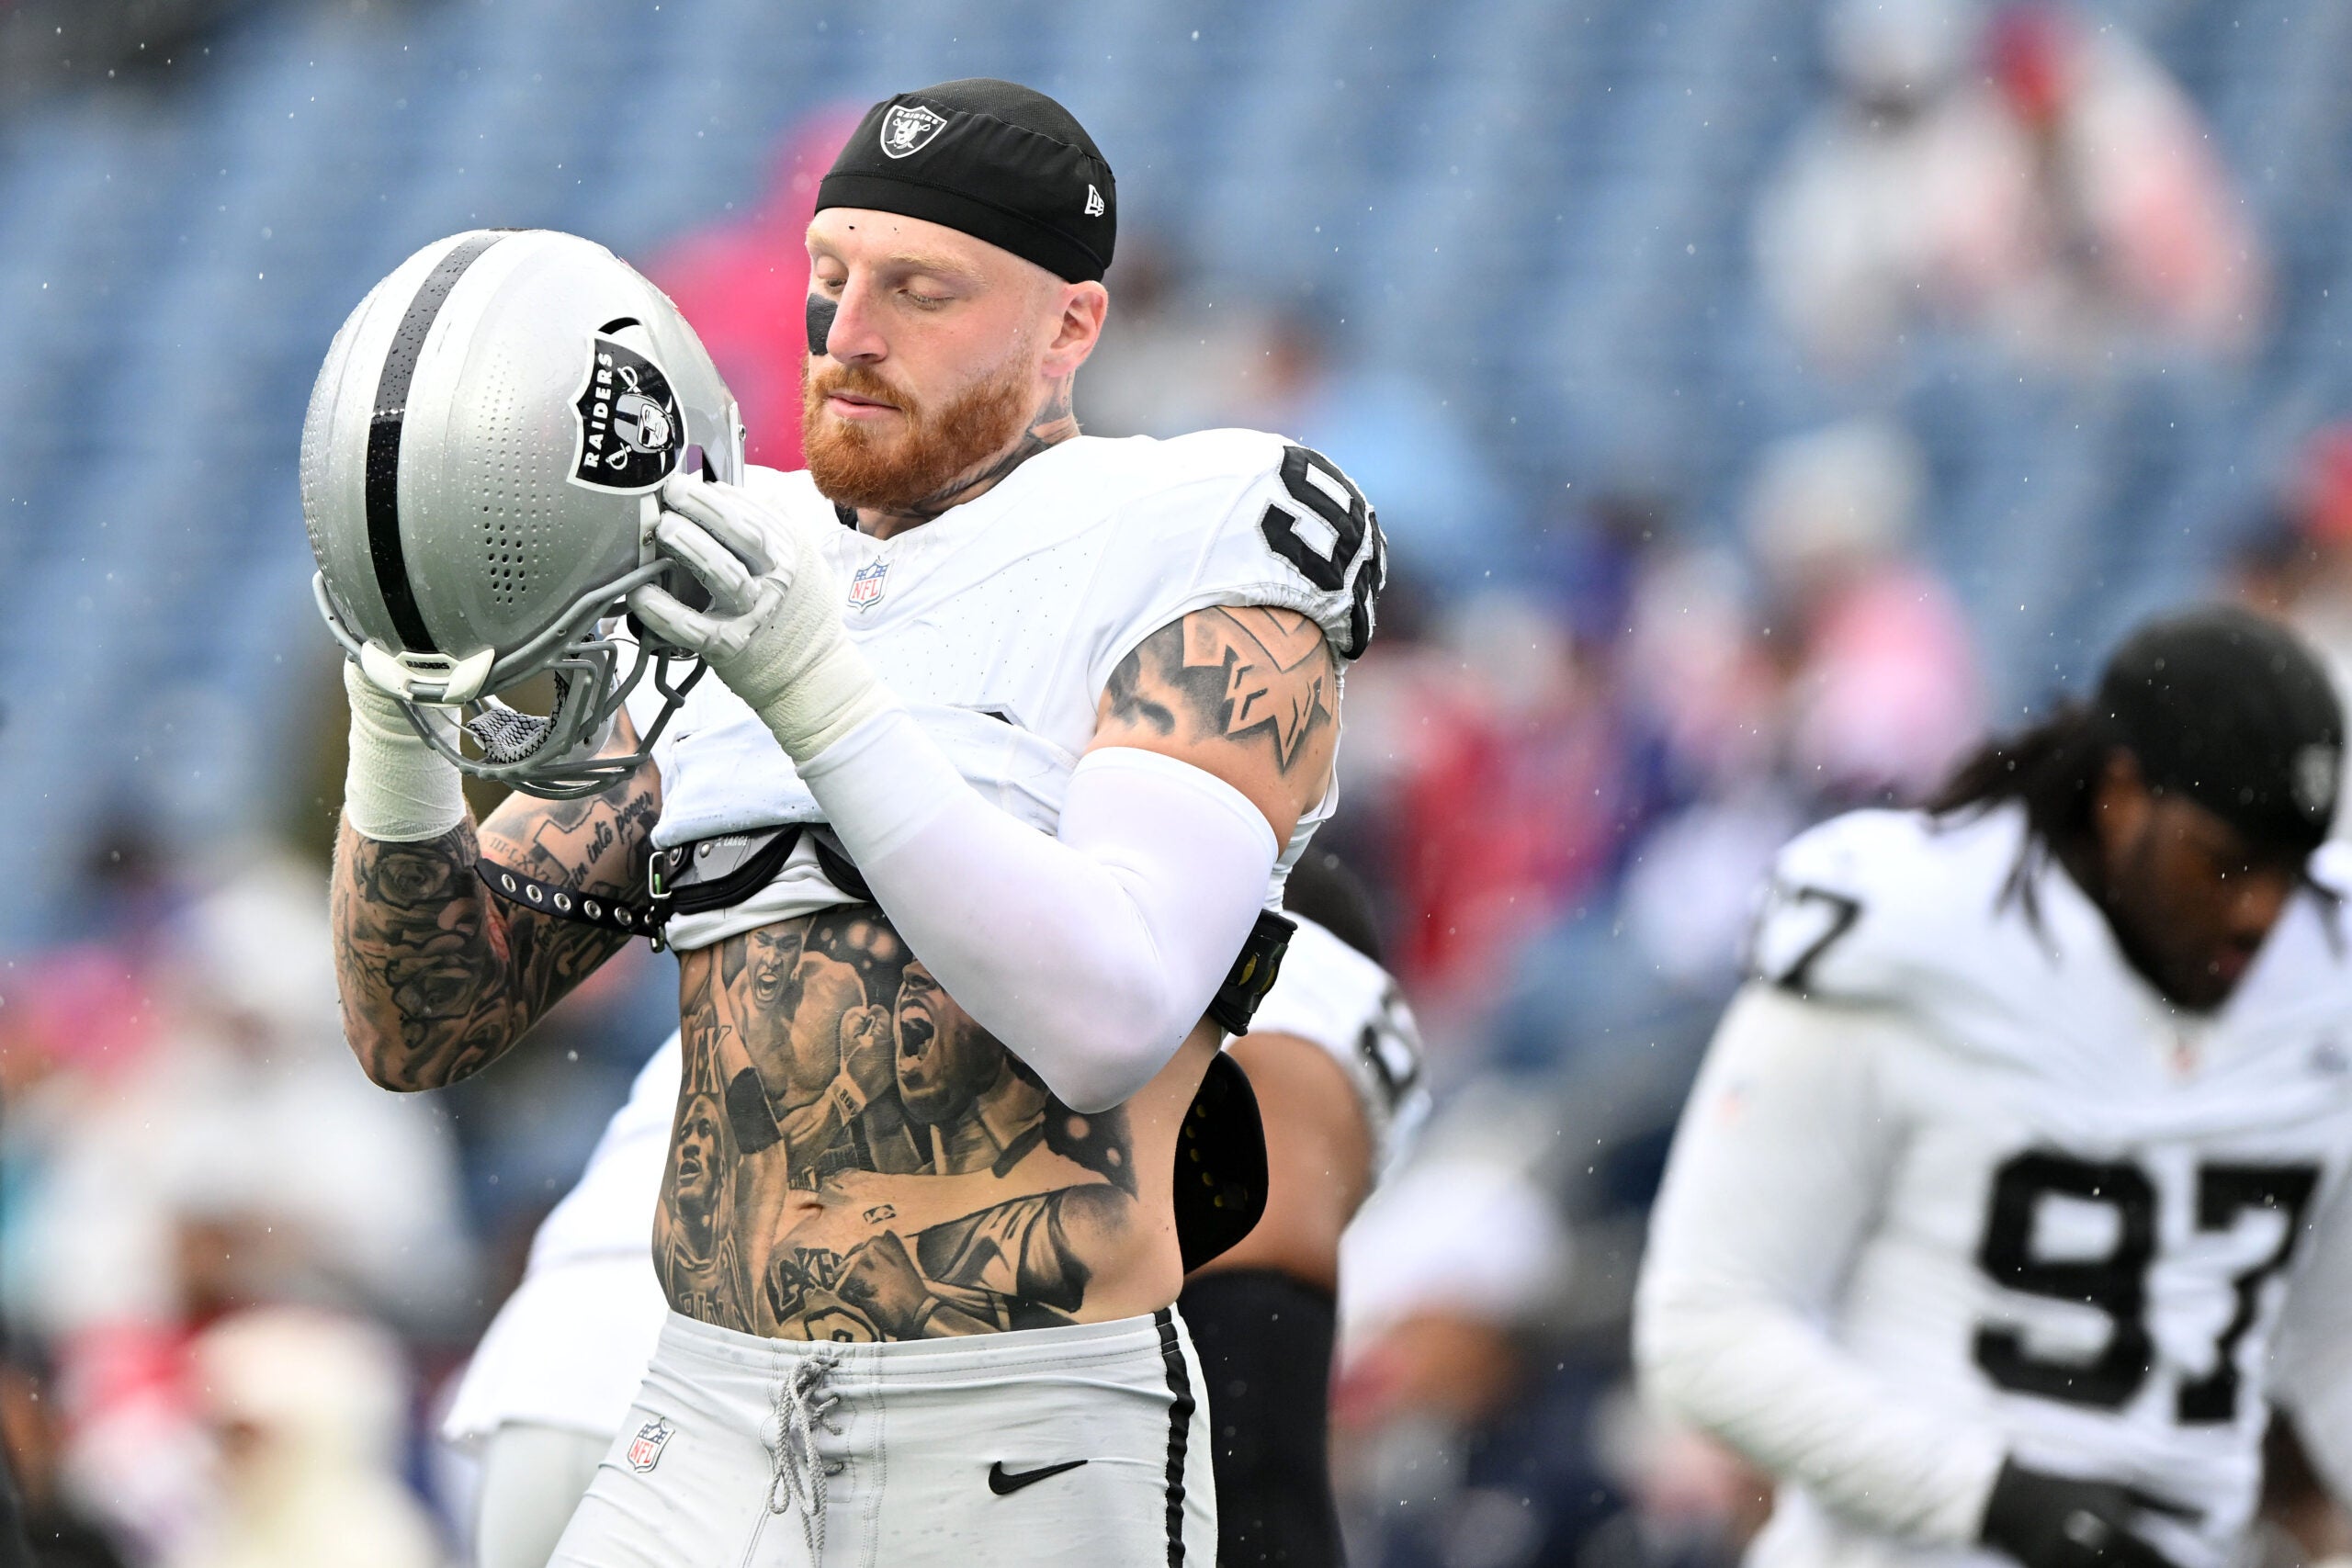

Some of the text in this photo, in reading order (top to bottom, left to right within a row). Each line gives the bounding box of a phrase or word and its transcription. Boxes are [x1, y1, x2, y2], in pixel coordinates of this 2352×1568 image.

[583, 352, 613, 468] RAIDERS
[852, 579, 878, 601] NFL
[405, 660, 450, 670] RAIDERS
[585, 819, 614, 864] into
[764, 1247, 845, 1326] LAKE
[1973, 1146, 2323, 1427] 97
[630, 1438, 654, 1464] NFL
